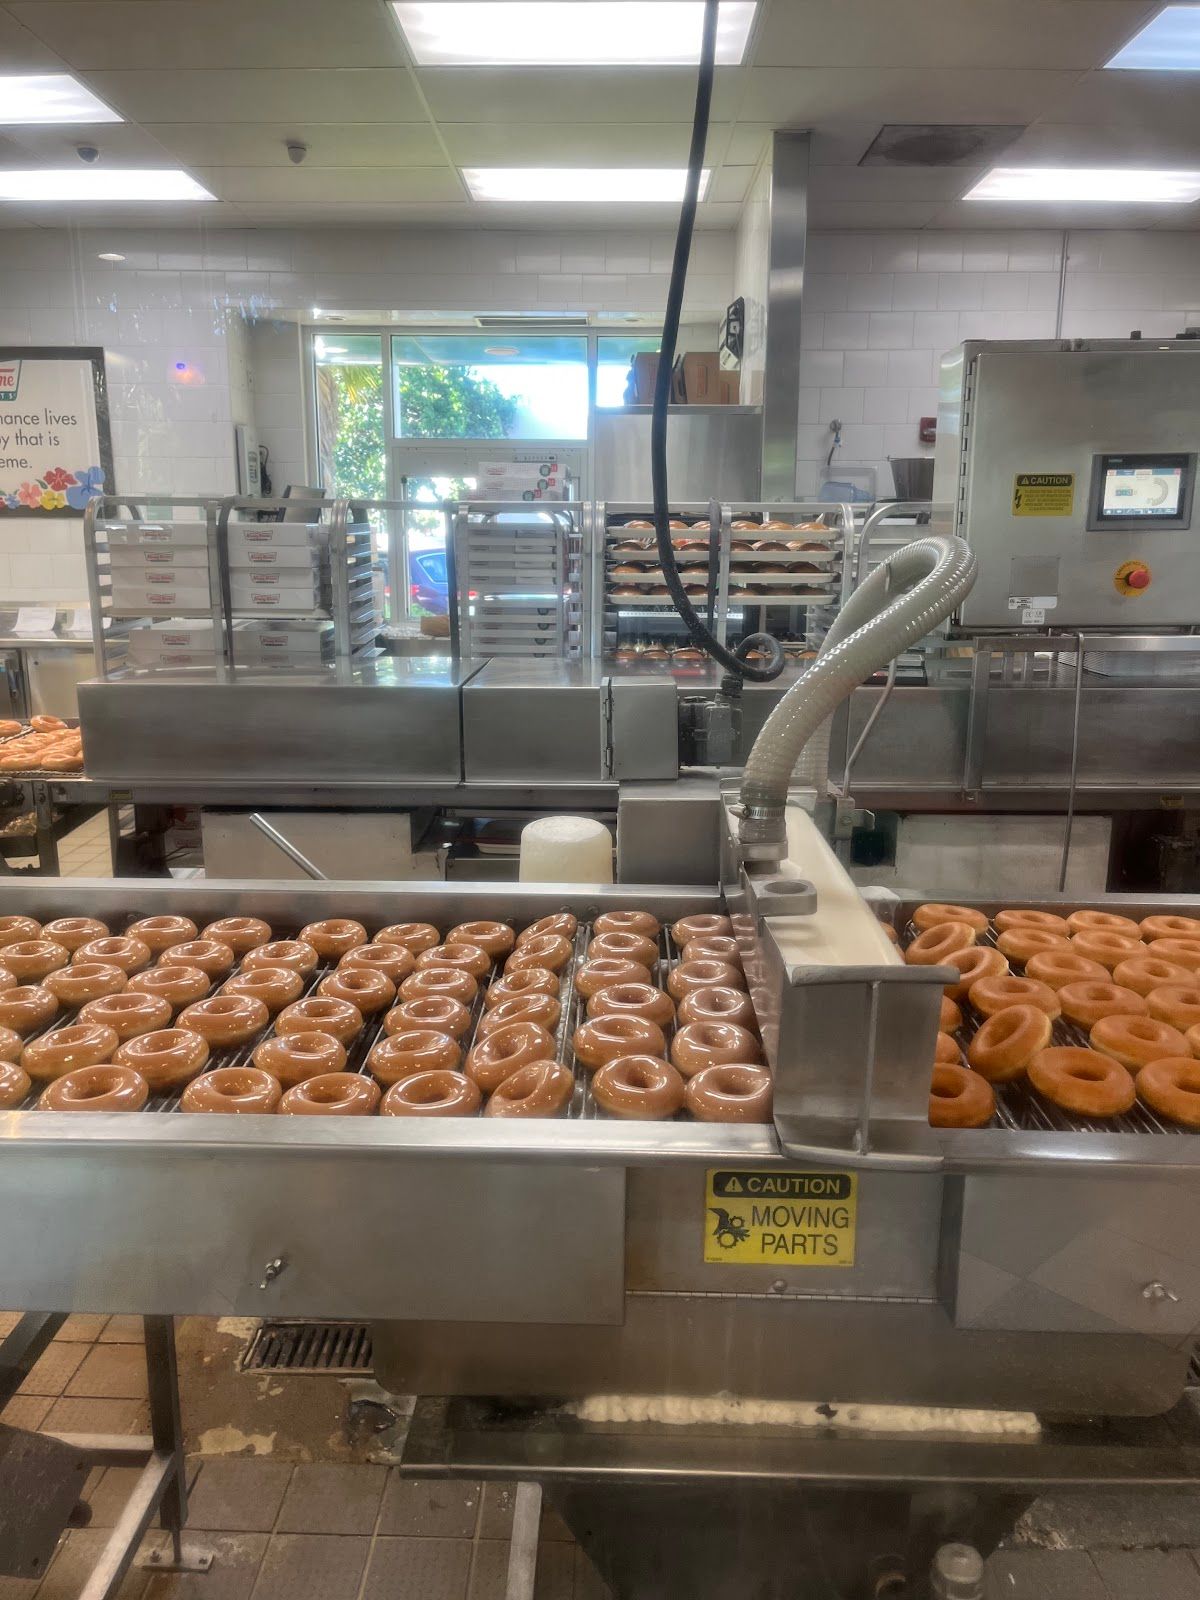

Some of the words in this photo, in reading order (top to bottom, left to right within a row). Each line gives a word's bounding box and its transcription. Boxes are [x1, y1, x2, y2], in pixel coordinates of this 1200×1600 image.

[45, 408, 77, 426] lives
[15, 428, 43, 446] that
[48, 431, 60, 446] is
[1030, 476, 1069, 485] CAUTION
[747, 1177, 840, 1194] CAUTION
[751, 1205, 849, 1229] MOVING
[761, 1233, 838, 1256] PARTS
